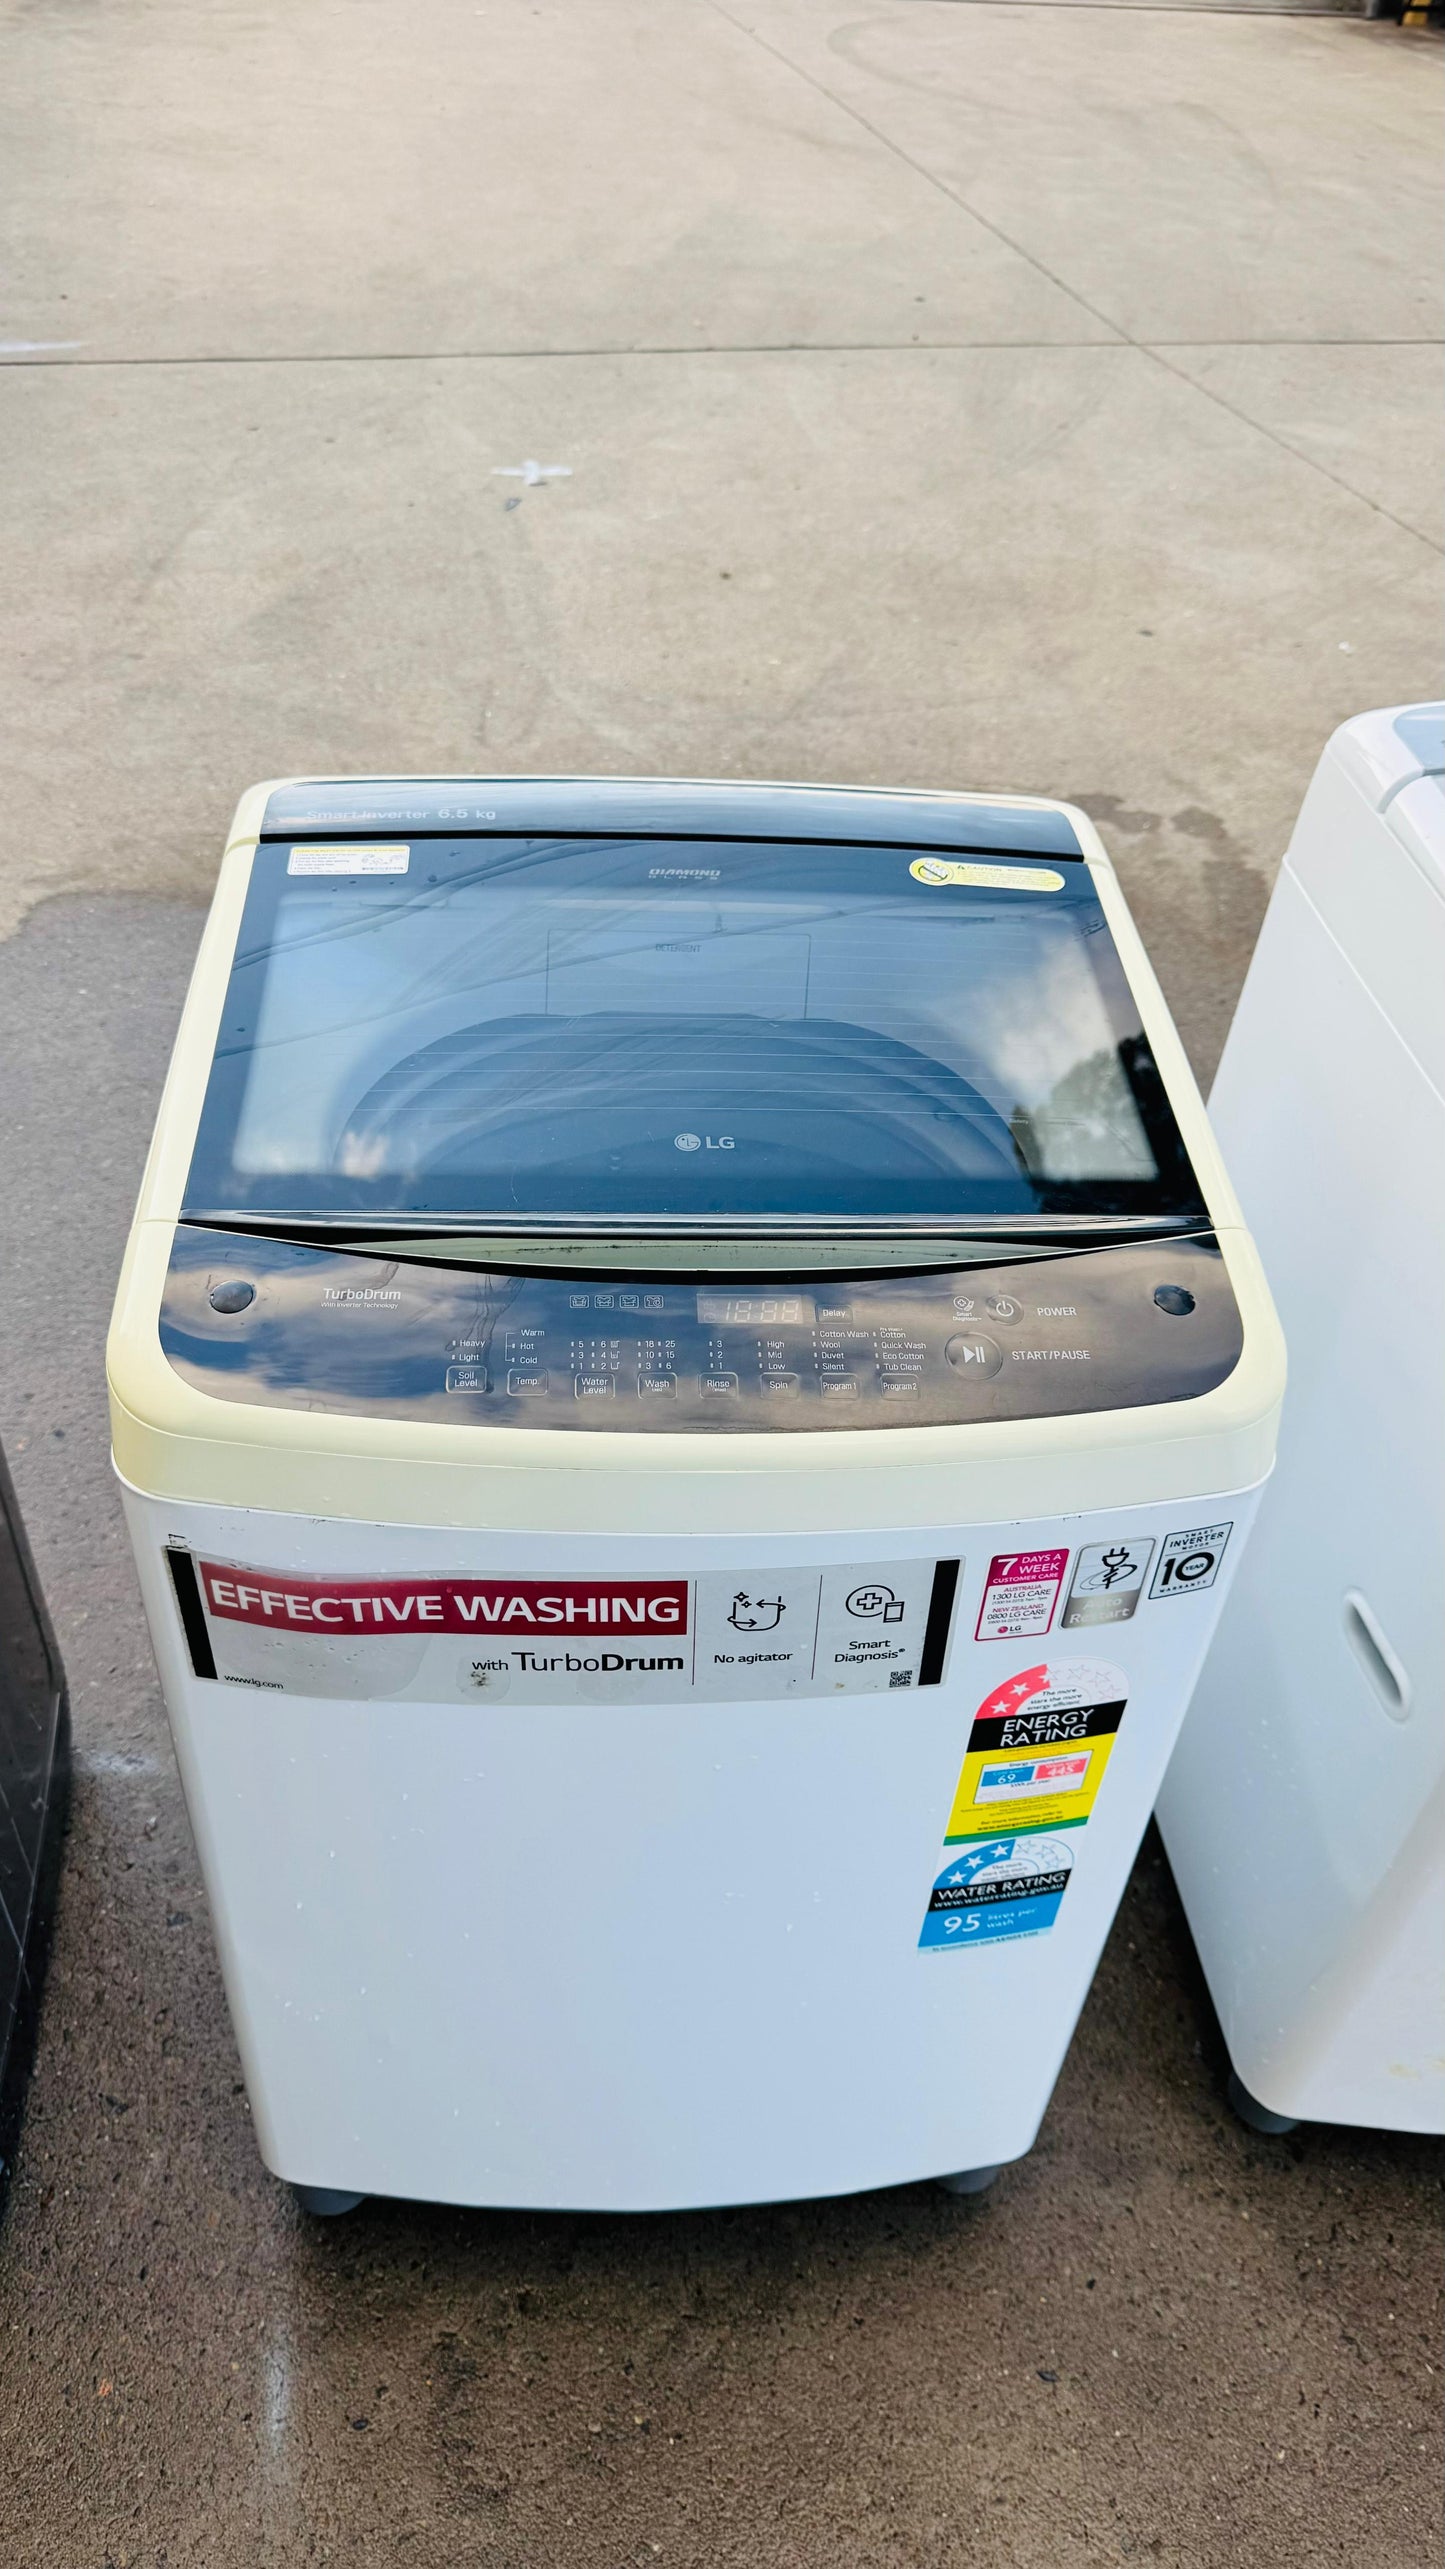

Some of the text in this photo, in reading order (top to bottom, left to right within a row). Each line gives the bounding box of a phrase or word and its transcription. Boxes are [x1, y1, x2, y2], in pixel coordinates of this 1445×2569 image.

[438, 808, 468, 820] 6.5
[475, 809, 496, 821] kg
[648, 868, 721, 876] DIAMOND
[705, 1136, 735, 1149] LG
[323, 1288, 401, 1300] TurboDrum
[822, 1309, 846, 1318] Delay
[1037, 1306, 1077, 1316] POWER
[819, 1330, 870, 1338] Cotton Wash
[460, 1340, 486, 1348] Heavy
[520, 1342, 534, 1350] Hot
[646, 1340, 676, 1348] 18 25
[717, 1340, 722, 1348] 3
[767, 1340, 785, 1350] High
[904, 1342, 927, 1350] Wash
[459, 1354, 480, 1362] Light
[578, 1351, 606, 1359] 3 4
[646, 1351, 675, 1359] 10 15
[768, 1351, 782, 1359] Mid
[821, 1352, 844, 1360] Duvet
[882, 1352, 925, 1360] Eco Cotton
[1012, 1350, 1091, 1361] START/PAUSE
[520, 1356, 538, 1364] Cold
[580, 1362, 606, 1370] 1 2
[646, 1362, 672, 1370] 3 6
[718, 1362, 722, 1370] 1
[768, 1362, 786, 1370] Low
[822, 1362, 845, 1370] Silent
[900, 1363, 922, 1371] Clean
[458, 1371, 474, 1380] Soil
[454, 1379, 478, 1387] Level
[515, 1377, 540, 1386] Temp.
[581, 1378, 608, 1386] Water
[644, 1379, 670, 1388] Wash
[706, 1380, 730, 1388] Rinse
[769, 1380, 788, 1390] Spin
[583, 1386, 606, 1395] Level
[823, 1382, 851, 1392] Program
[883, 1382, 918, 1392] Program 2
[1185, 1528, 1214, 1538] SMART
[1170, 1530, 1225, 1548] INVERTER
[1182, 1542, 1210, 1550] MOTOR
[1022, 1554, 1051, 1564] DAYS
[998, 1557, 1018, 1576] 7
[1019, 1562, 1060, 1574] WEEK
[1161, 1551, 1215, 1586] 10
[1185, 1562, 1205, 1572] YEAR
[992, 1572, 1059, 1584] CUSTOMER CARE
[1004, 1584, 1042, 1592] AUSTRALIA
[1159, 1580, 1207, 1593] WARRANTY
[992, 1592, 1012, 1601] 1300
[1027, 1588, 1052, 1597] CARE
[210, 1578, 681, 1624] EFFECTIVE WASHING
[1082, 1598, 1122, 1610] Auto
[1010, 1604, 1044, 1612] ZEALAND
[986, 1612, 1008, 1620] 0800
[1022, 1608, 1048, 1617] CARE
[848, 1639, 891, 1651] Smart
[472, 1652, 684, 1672] with TurboDrum
[714, 1651, 794, 1665] No agitator
[224, 1675, 284, 1689] www.lg.com
[1004, 1708, 1094, 1733] ENERGY
[1000, 1724, 1088, 1748] RATING
[997, 1773, 1016, 1784] 69
[938, 1872, 1067, 1901] WATER RATING
[934, 1883, 1064, 1908] www.waterrating.gov.au
[944, 1912, 982, 1935] 95
[986, 1920, 1014, 1929] wash
